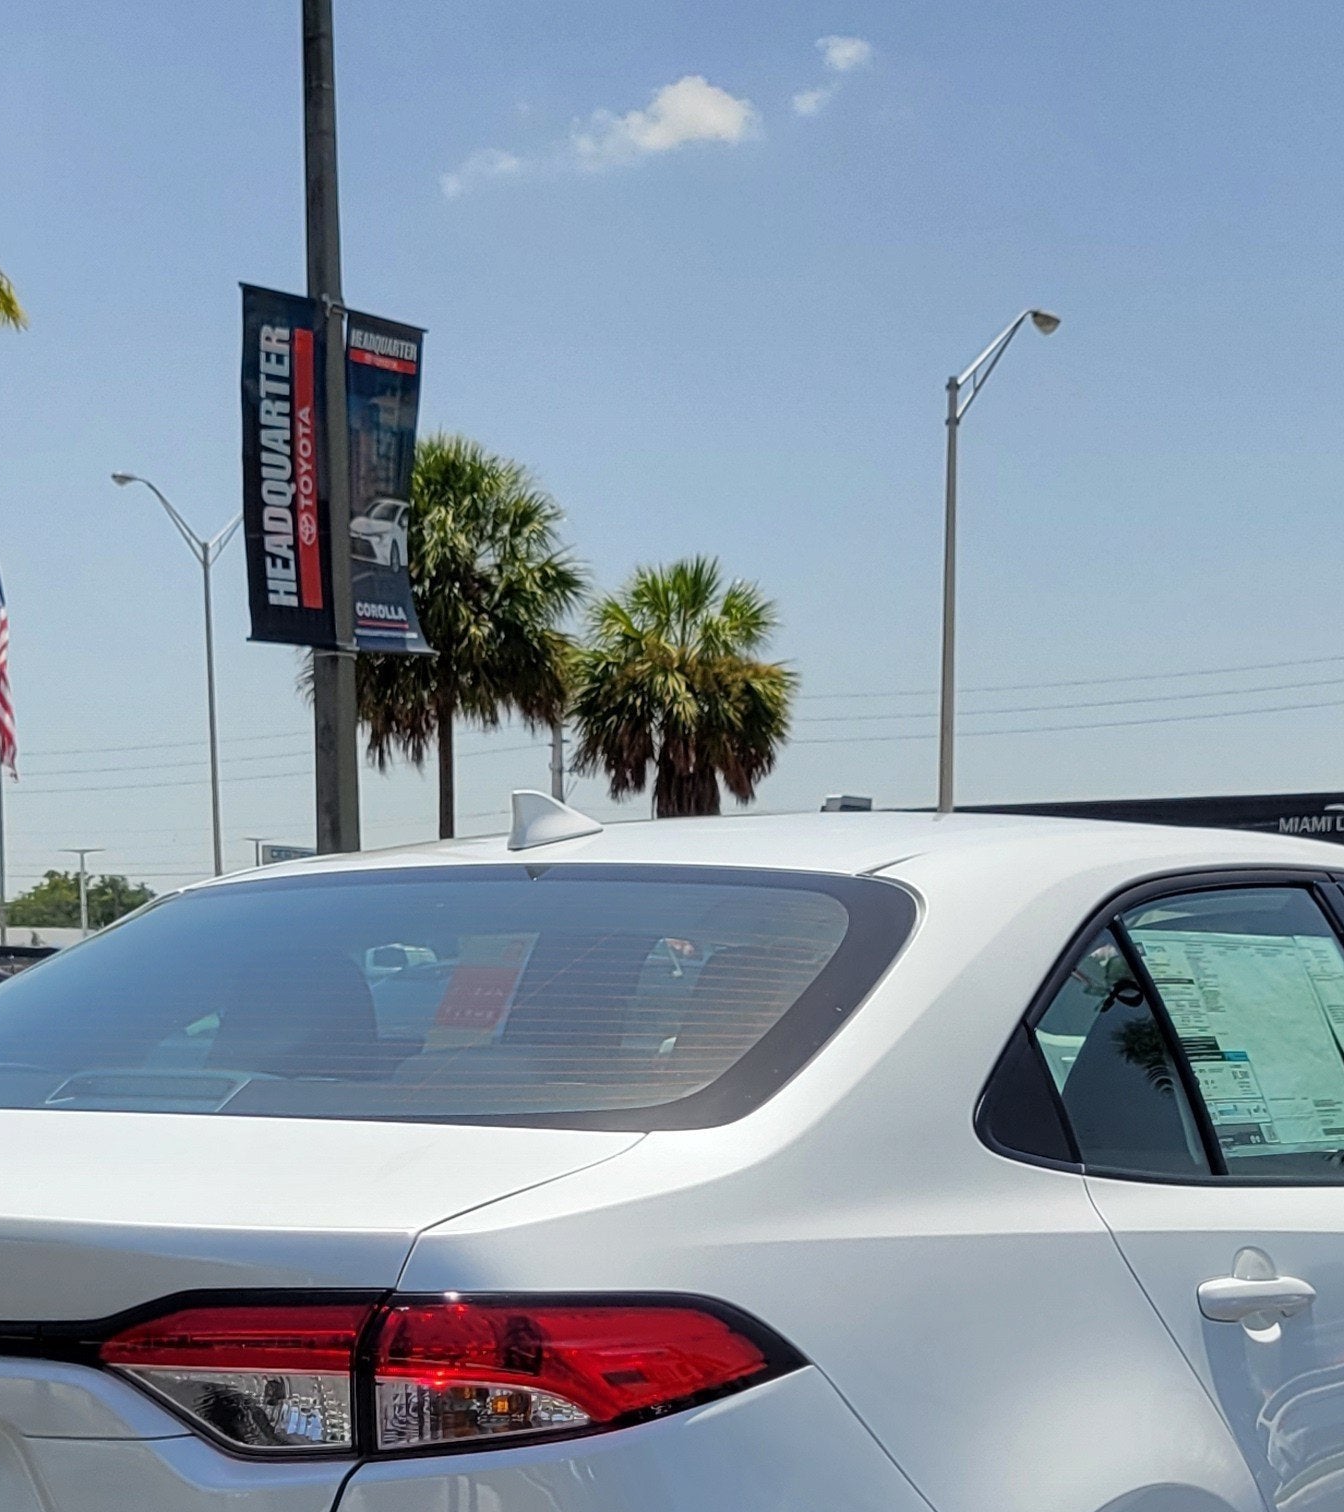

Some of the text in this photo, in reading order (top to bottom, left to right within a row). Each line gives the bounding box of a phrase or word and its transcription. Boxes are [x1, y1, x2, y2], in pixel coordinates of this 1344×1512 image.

[351, 327, 418, 362] HEADQUARTER
[259, 325, 298, 608] HEADQUARTER
[297, 406, 313, 511] TOYOTA
[356, 602, 408, 621] COROLLA
[1278, 816, 1333, 833] MIAMI
